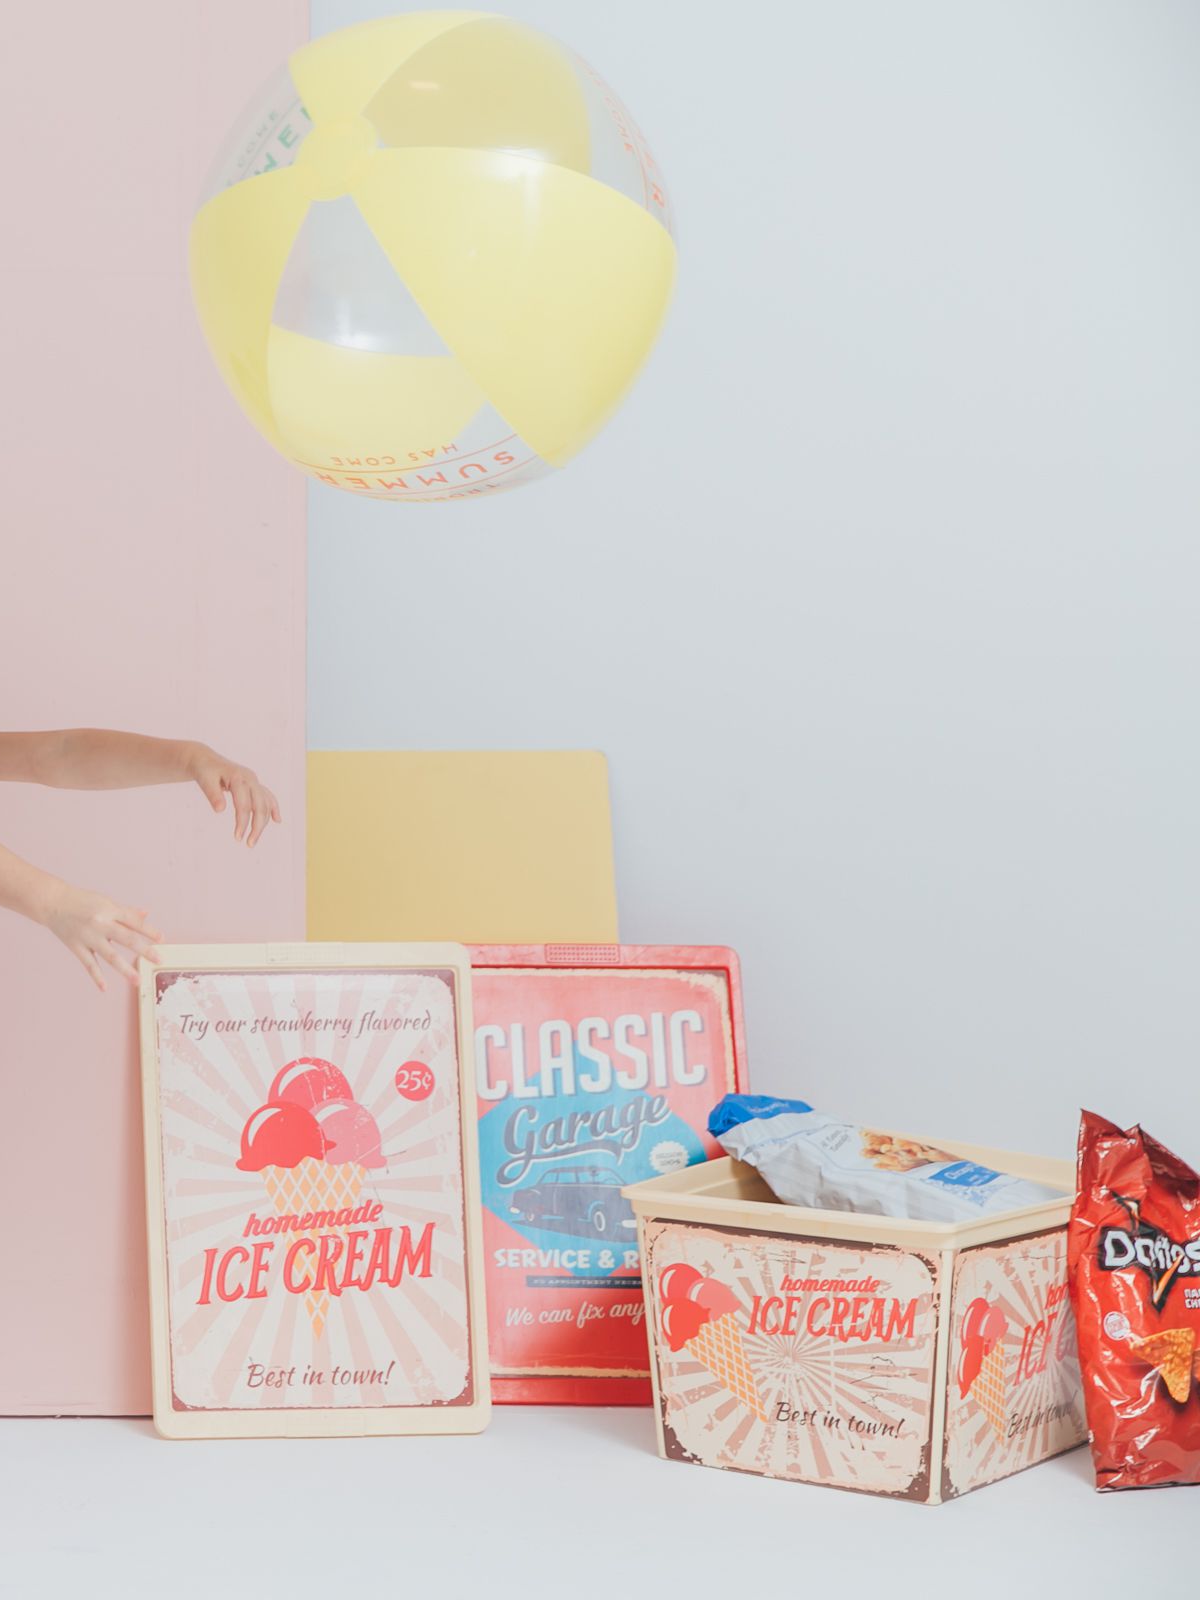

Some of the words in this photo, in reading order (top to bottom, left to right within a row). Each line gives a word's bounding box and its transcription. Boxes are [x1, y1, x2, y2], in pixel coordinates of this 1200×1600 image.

[330, 456, 396, 467] COME
[408, 443, 459, 462] HAS
[315, 451, 515, 490] SUMMER
[179, 1014, 209, 1040] Try
[215, 1020, 247, 1033] our
[250, 1010, 353, 1039] strawberry
[355, 1009, 432, 1039] flavored
[474, 1009, 708, 1101] CLASSIC
[396, 1069, 433, 1090] 25¢
[496, 1094, 672, 1187] Garage
[242, 1199, 384, 1238] homemade
[196, 1240, 275, 1305] ICE
[283, 1222, 436, 1297] CREAM
[493, 1248, 591, 1269] SERVICE
[598, 1249, 615, 1269] &
[780, 1274, 881, 1293] homemade
[505, 1307, 534, 1327] We
[538, 1308, 573, 1324] can
[576, 1301, 605, 1329] fix
[745, 1295, 802, 1336] ICE
[806, 1297, 919, 1343] CREAM
[246, 1363, 296, 1388] Best
[302, 1365, 325, 1385] in
[331, 1360, 396, 1386] town!
[776, 1401, 817, 1426] Best
[823, 1410, 841, 1429] in
[847, 1415, 906, 1439] town!
